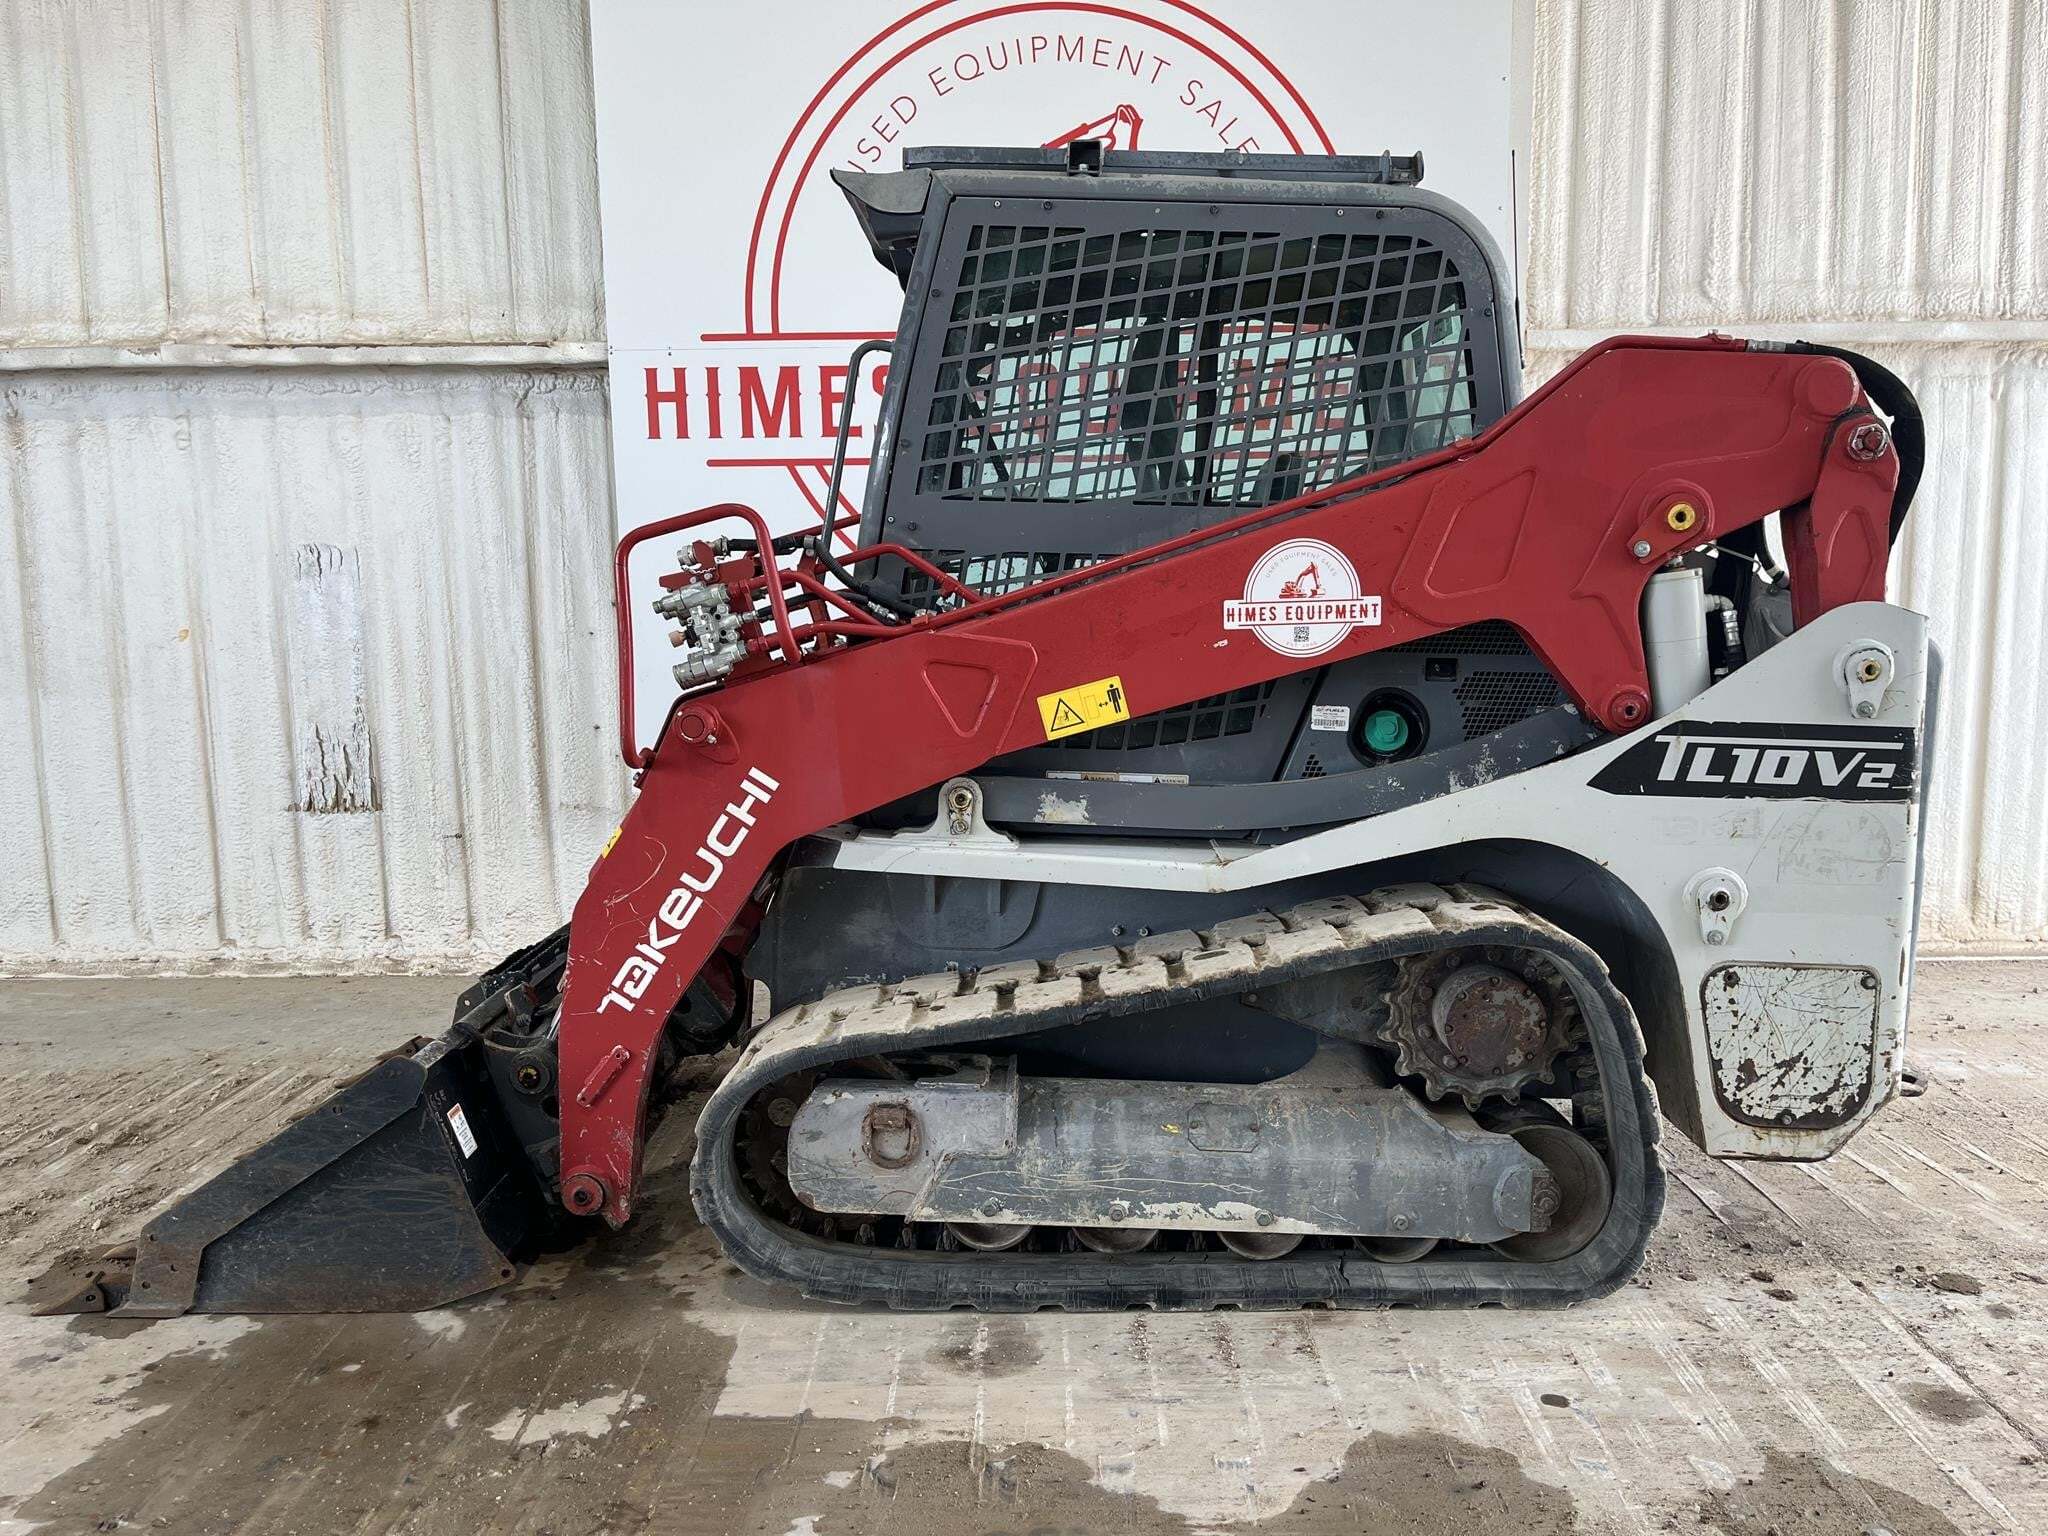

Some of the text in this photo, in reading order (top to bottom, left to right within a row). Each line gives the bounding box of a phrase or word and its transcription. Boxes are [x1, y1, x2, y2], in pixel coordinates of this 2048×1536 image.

[928, 35, 1171, 97] EQUIPMENT
[1180, 80, 1260, 154] SALE
[1226, 603, 1379, 623] HIMES EQUIPMENT
[1654, 735, 1904, 788] TL10V2
